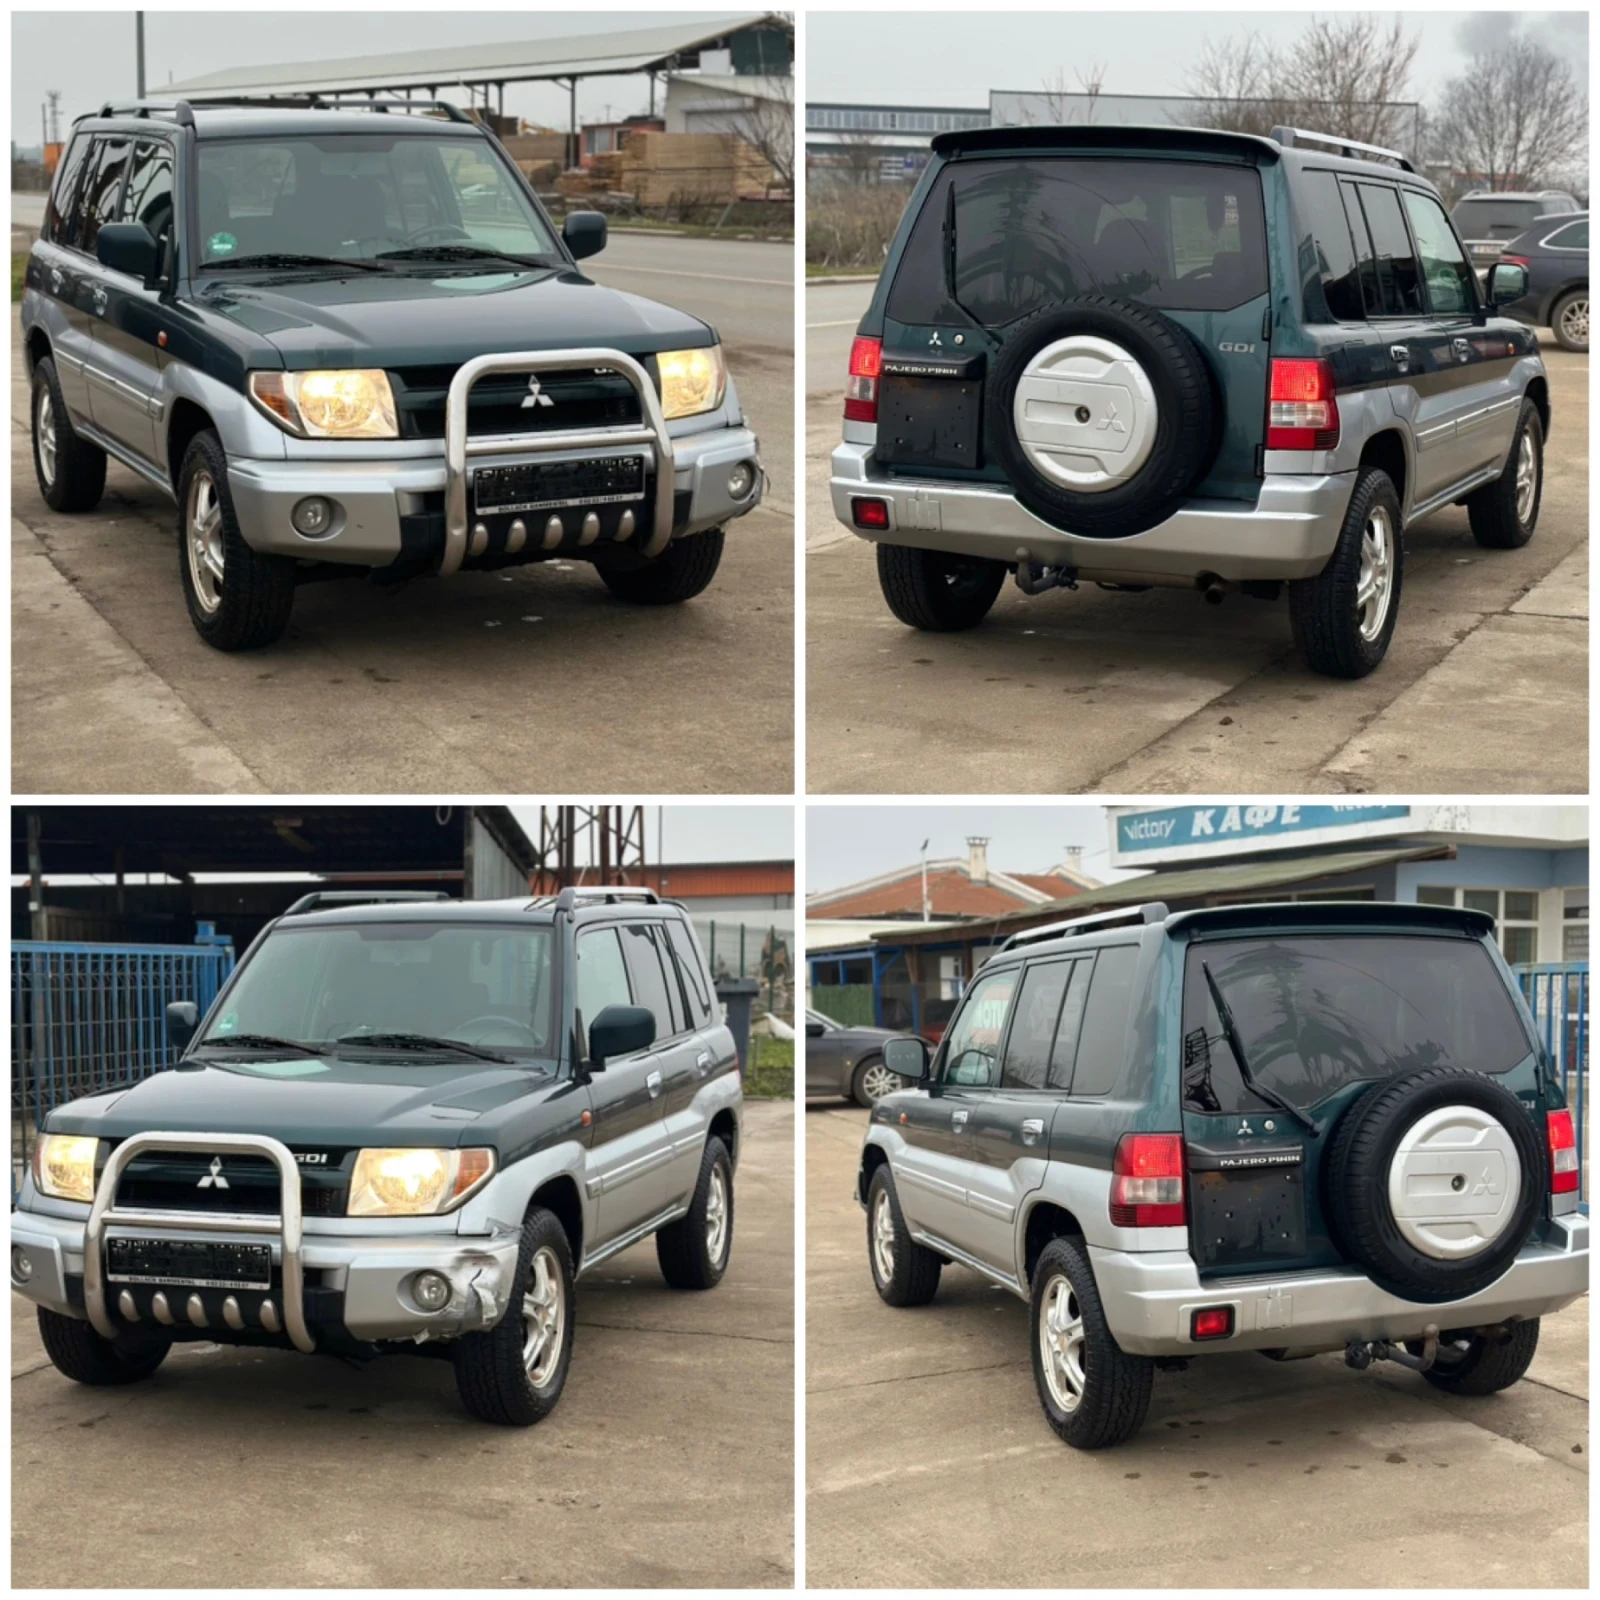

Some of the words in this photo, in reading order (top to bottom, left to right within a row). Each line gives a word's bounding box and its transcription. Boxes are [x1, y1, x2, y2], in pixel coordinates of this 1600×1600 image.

[1219, 342, 1256, 353] GDI
[884, 364, 926, 374] PAJERO
[1220, 1156, 1267, 1167] PAJERO
